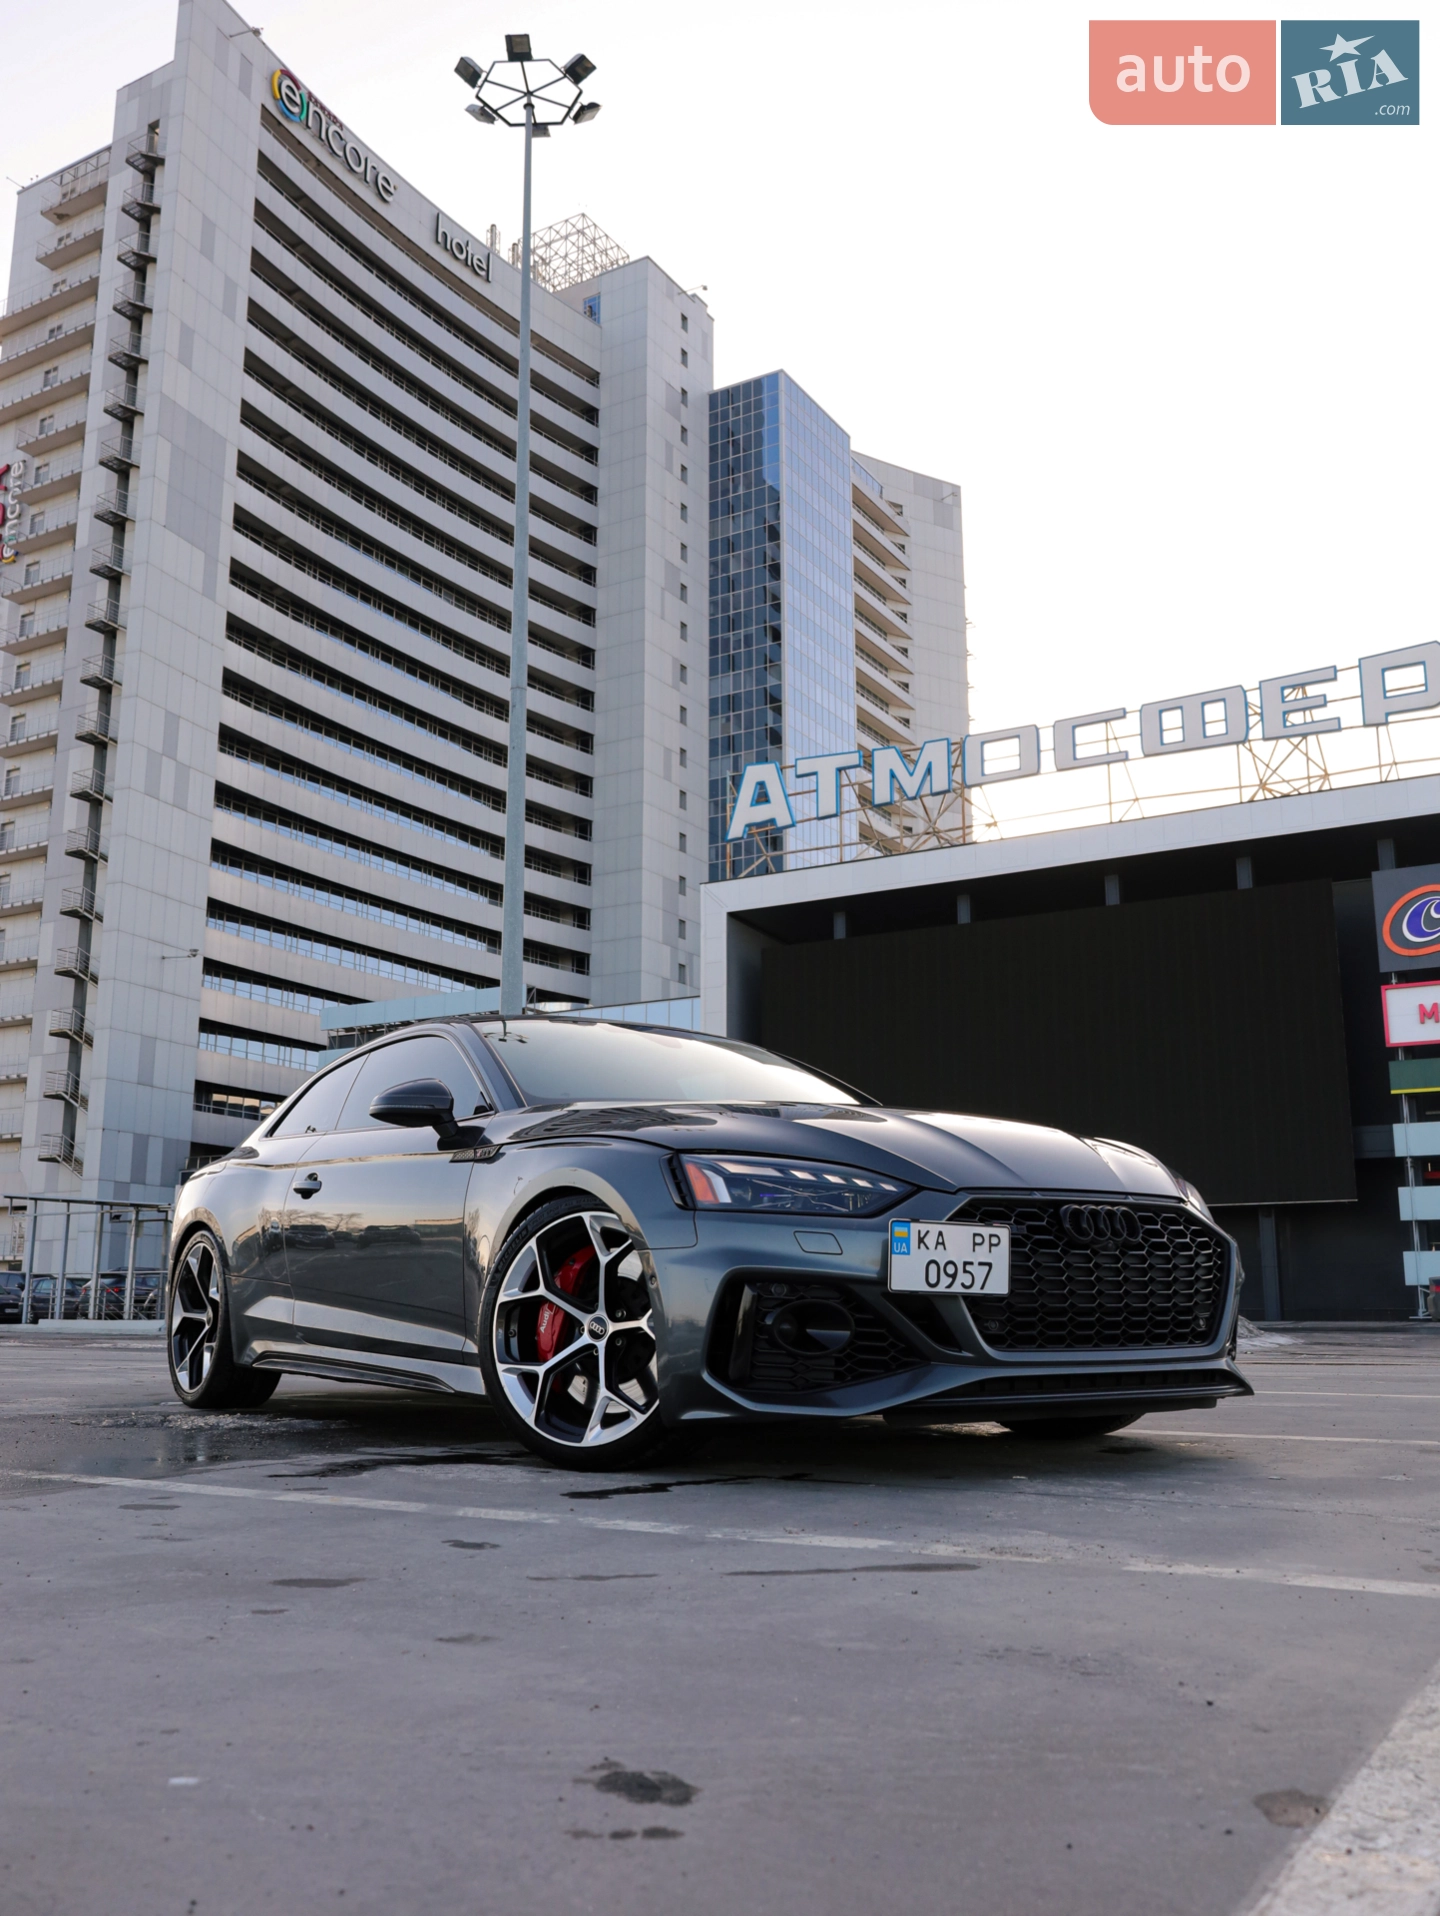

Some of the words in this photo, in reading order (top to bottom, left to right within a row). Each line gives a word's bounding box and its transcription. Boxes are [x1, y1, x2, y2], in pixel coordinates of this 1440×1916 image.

[279, 77, 396, 204] encore
[435, 211, 493, 284] hotel
[498, 1228, 528, 1271] MICHELIN
[893, 1241, 908, 1254] UA
[917, 1229, 947, 1251] KA
[973, 1232, 1001, 1254] PP
[924, 1258, 993, 1291] 0957
[540, 1310, 551, 1334] Audi
